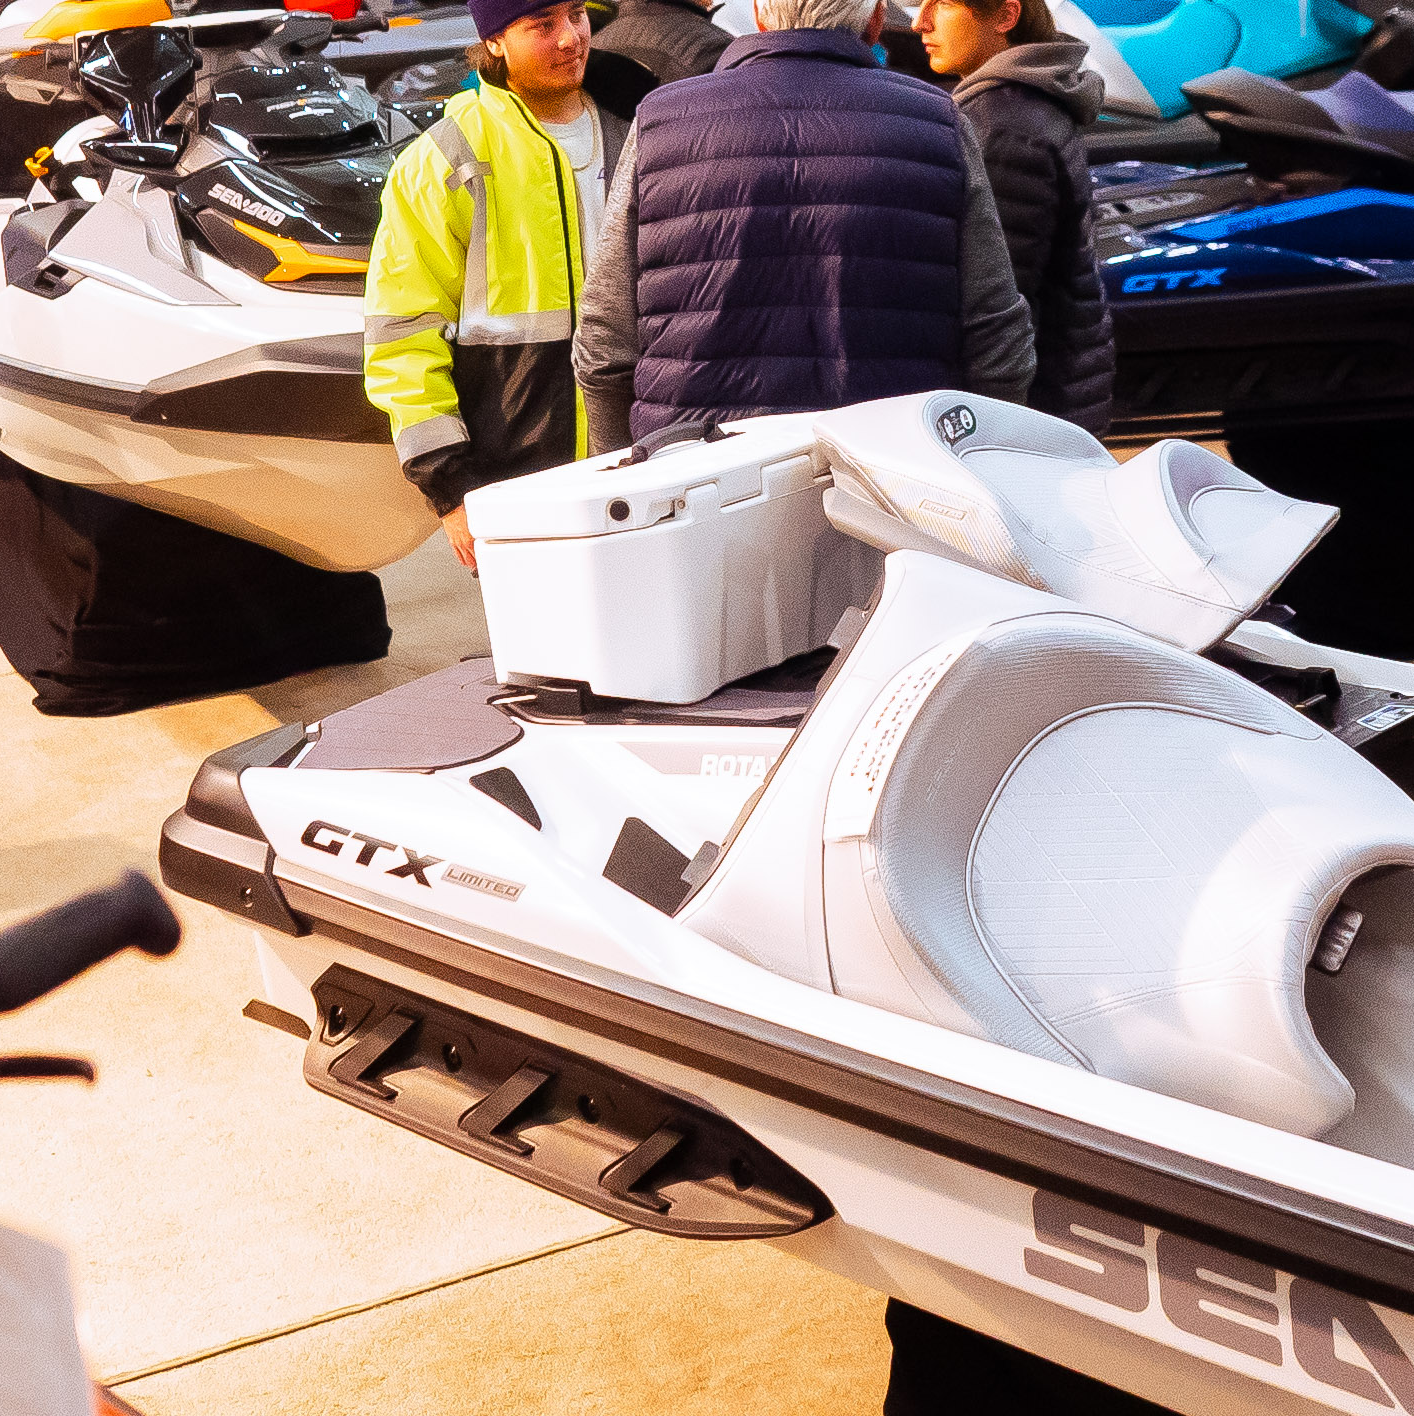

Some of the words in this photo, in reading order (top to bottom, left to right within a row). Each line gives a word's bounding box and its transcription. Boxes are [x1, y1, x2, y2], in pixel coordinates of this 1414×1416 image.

[1121, 267, 1228, 294] GTX
[300, 819, 447, 889] GTX
[445, 866, 522, 899] LIMITED
